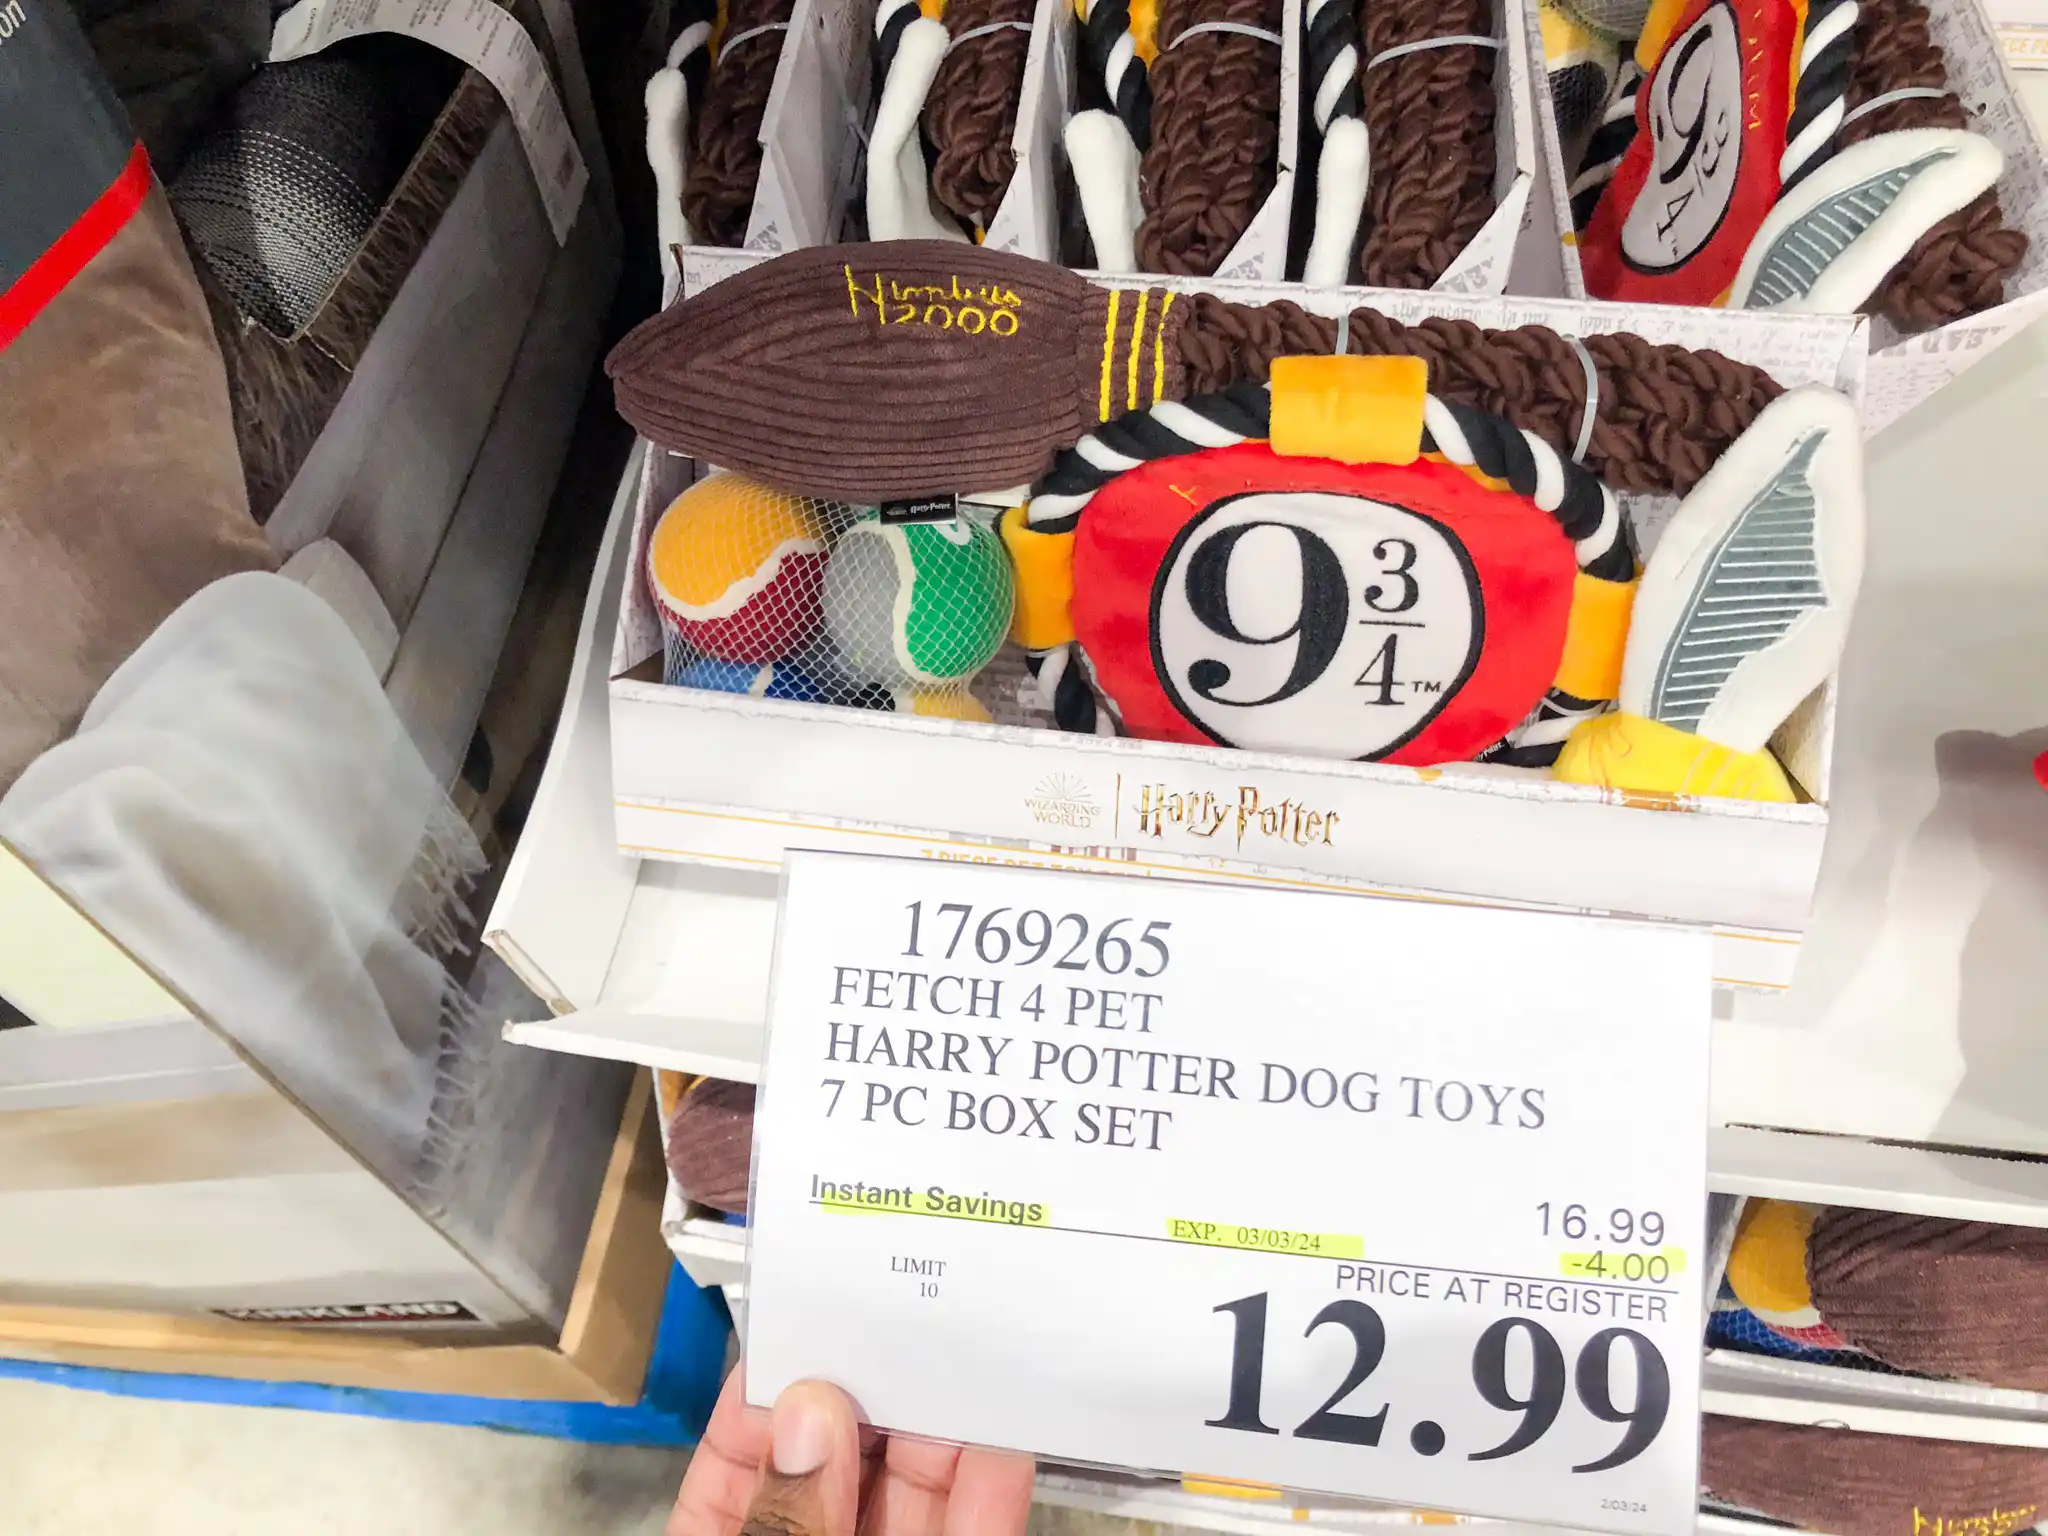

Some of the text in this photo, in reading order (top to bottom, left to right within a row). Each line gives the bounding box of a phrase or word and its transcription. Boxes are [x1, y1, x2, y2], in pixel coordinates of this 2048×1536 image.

[892, 303, 1019, 336] 2000
[1185, 521, 1419, 707] 9 3
[1354, 633, 1405, 706] 4
[1023, 797, 1101, 818] WIZARDING
[1033, 809, 1093, 829] WORLD
[1132, 783, 1342, 853] Harry Potter
[900, 900, 1172, 978] 1769265
[830, 966, 1163, 1033] FETCH 4 PET
[824, 1022, 1546, 1130] HARRY POTTER DOG TOYS
[820, 1078, 1173, 1151] 7 PC BOX SET
[811, 1174, 1043, 1224] Instant Savings
[1536, 1201, 1665, 1247] 16.99
[1173, 1219, 1322, 1252] EXP. 03/03/24
[890, 1256, 947, 1277] LIMIT
[919, 1282, 938, 1299] 10
[1570, 1250, 1670, 1284] -4.00
[1336, 1264, 1669, 1322] PRICE AT REGISTER
[1204, 1291, 1670, 1474] 12.99
[1600, 1497, 1648, 1513] 2/03/24
